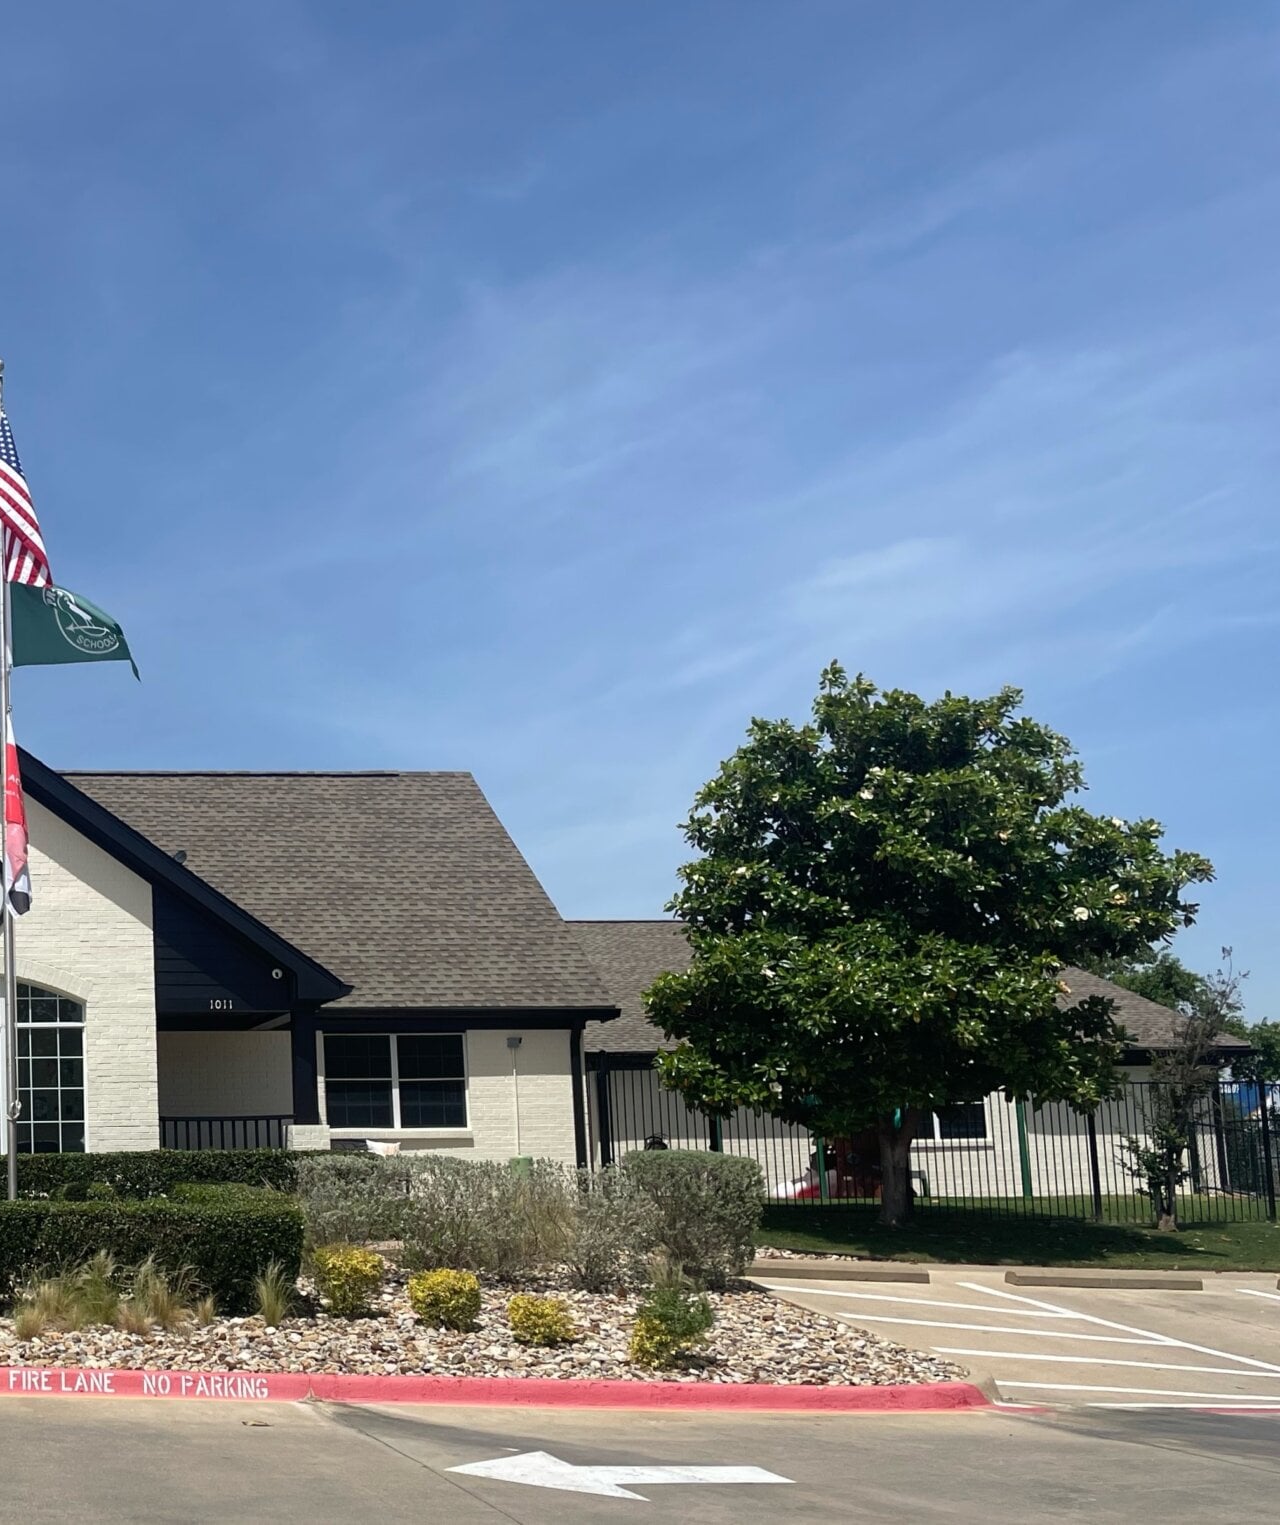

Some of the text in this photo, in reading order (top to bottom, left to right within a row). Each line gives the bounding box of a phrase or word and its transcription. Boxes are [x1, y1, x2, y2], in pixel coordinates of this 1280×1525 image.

[210, 999, 233, 1010] 1011
[9, 1369, 269, 1399] FIRE LANE NO PARKING
